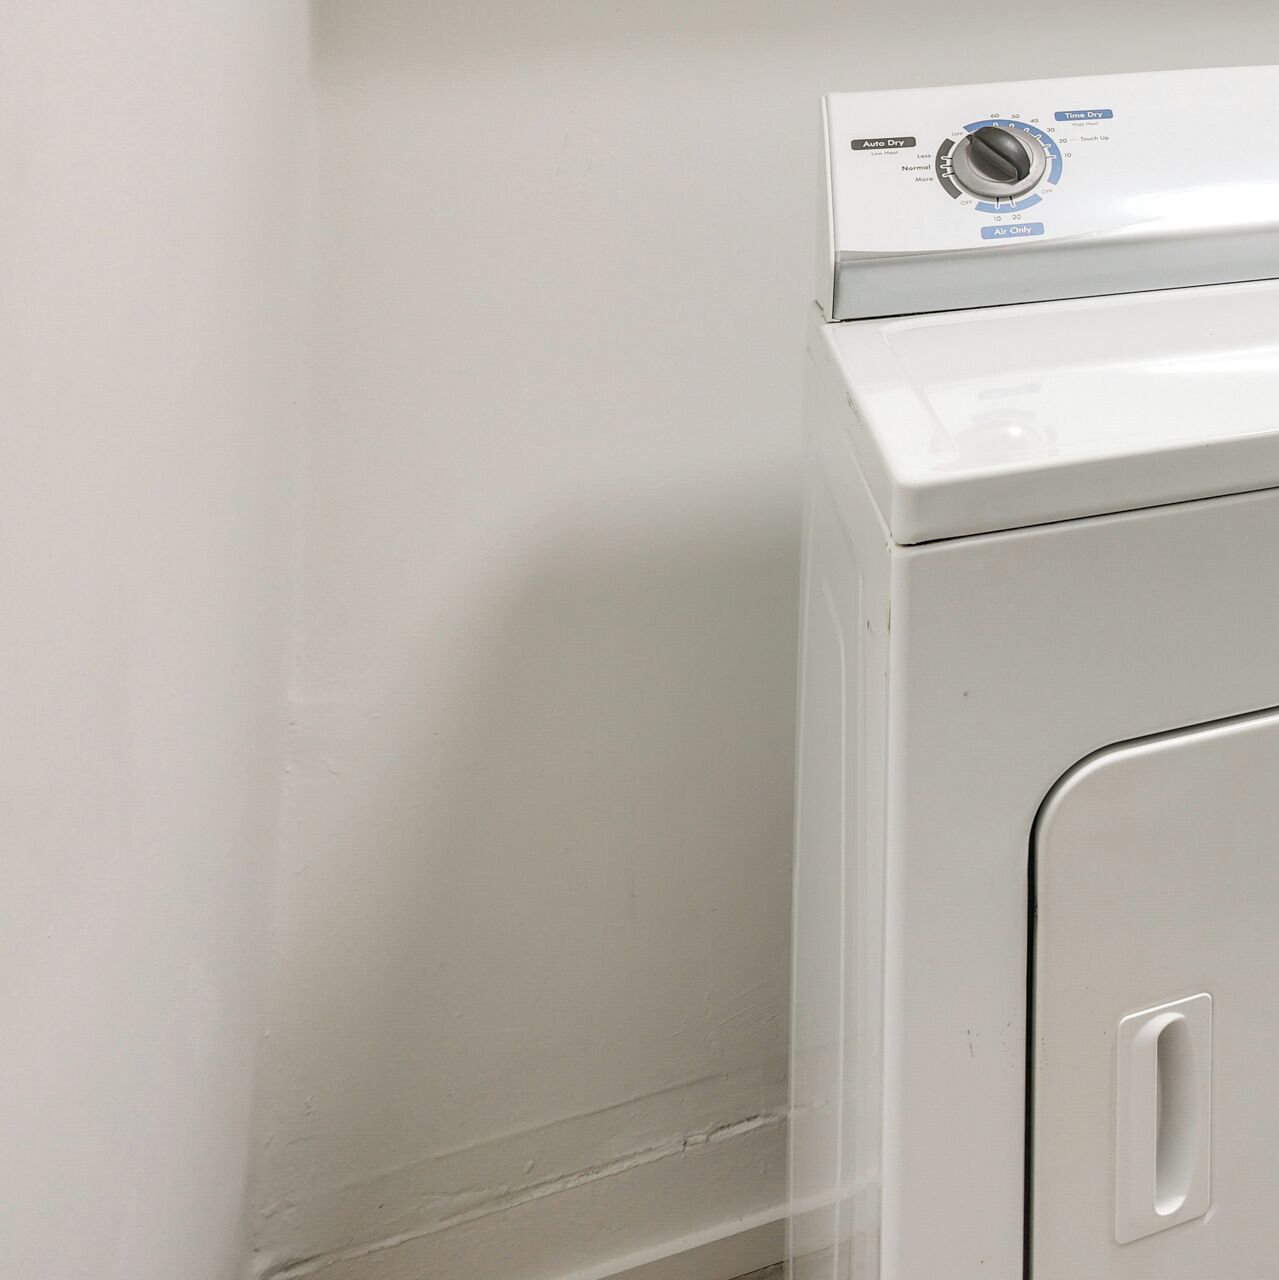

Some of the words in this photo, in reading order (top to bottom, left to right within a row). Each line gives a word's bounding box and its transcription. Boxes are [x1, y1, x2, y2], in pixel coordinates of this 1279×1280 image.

[1087, 111, 1103, 119] Dry
[862, 140, 885, 148] Auto
[887, 139, 904, 147] Dry
[1009, 226, 1032, 235] Only
